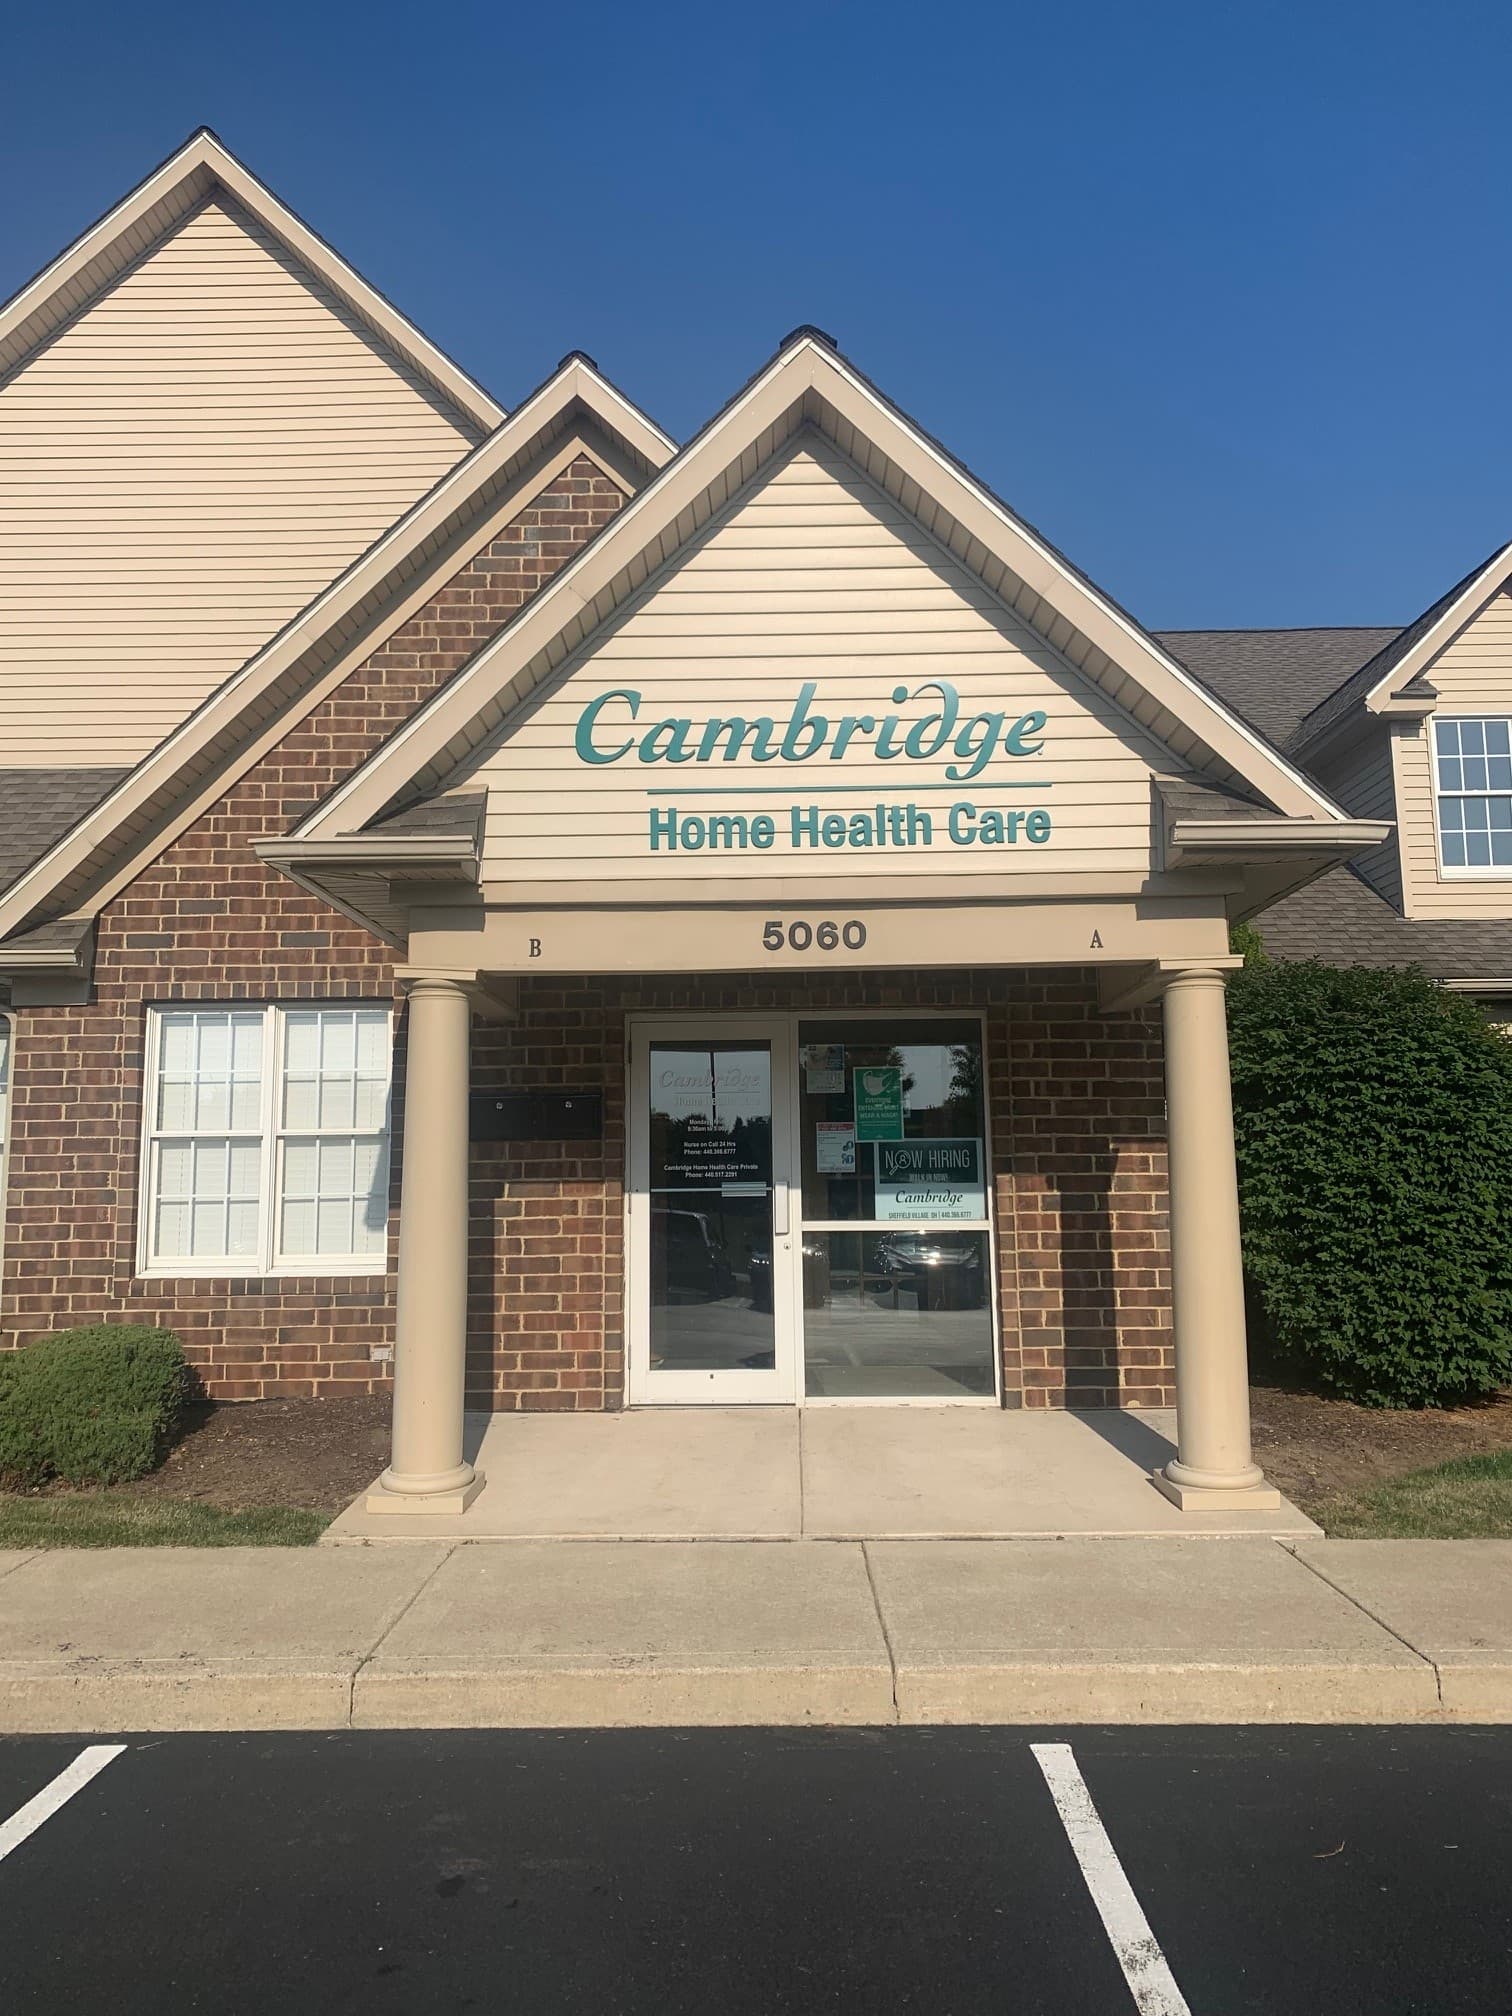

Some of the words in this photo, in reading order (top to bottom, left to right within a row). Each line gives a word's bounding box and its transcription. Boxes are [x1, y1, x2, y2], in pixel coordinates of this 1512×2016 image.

[574, 680, 1048, 780] Cambridge
[649, 807, 775, 850] Home
[791, 804, 932, 848] Health
[948, 801, 1051, 845] Care
[762, 920, 867, 951] 5060
[1089, 928, 1104, 949] A
[528, 938, 542, 958] B
[885, 1149, 923, 1169] NOW
[928, 1149, 970, 1169] HIRING
[895, 1189, 963, 1207] Cambridge
